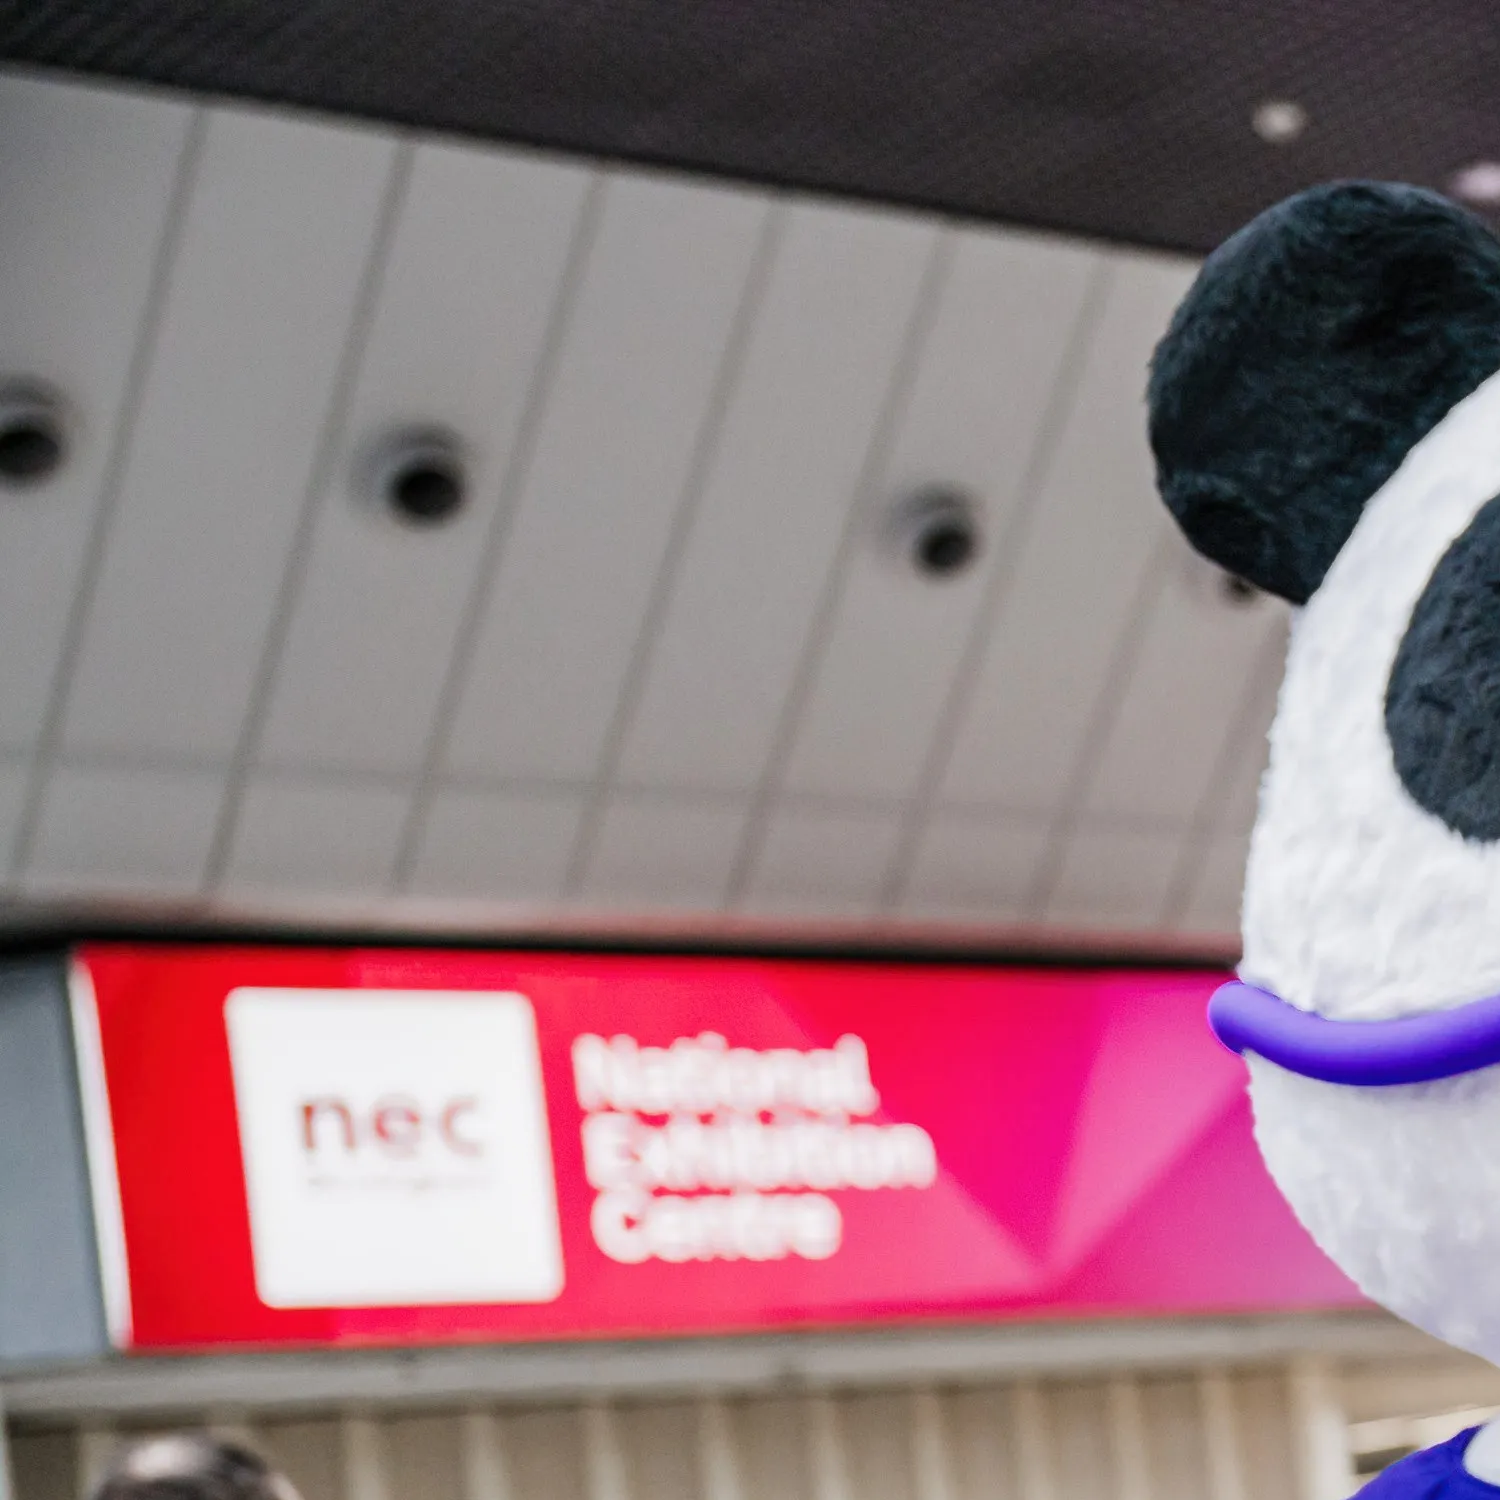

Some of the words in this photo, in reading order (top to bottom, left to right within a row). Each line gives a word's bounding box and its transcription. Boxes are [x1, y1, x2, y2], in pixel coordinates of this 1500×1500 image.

[572, 1031, 880, 1117] National
[298, 1094, 483, 1159] nec
[583, 1112, 937, 1190] Exhibition
[591, 1189, 842, 1263] Centre
